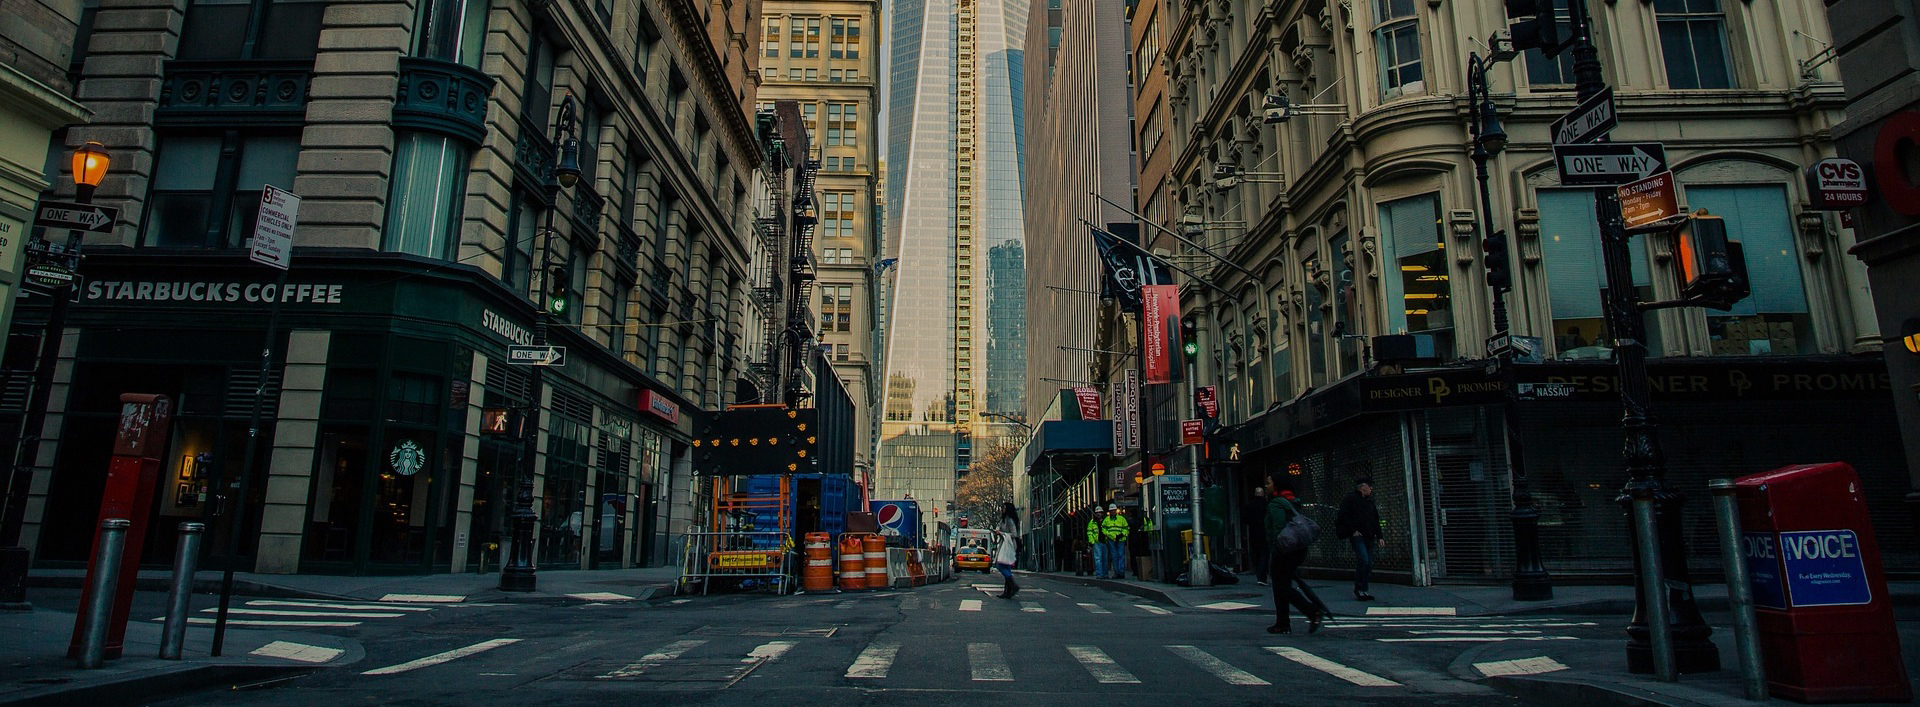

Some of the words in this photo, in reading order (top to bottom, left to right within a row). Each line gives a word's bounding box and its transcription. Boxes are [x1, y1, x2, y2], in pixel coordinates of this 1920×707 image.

[1562, 122, 1579, 144] ONE
[1586, 104, 1606, 129] WAY
[1574, 157, 1606, 172] ONE
[1618, 157, 1649, 172] WAY
[1820, 163, 1860, 179] CVS
[265, 188, 272, 202] 3
[1620, 188, 1630, 197] NO
[1632, 178, 1664, 194] STANDING
[1622, 196, 1642, 206] Monday
[1646, 190, 1662, 199] Friday
[263, 207, 289, 221] COMMERCIAL
[1639, 202, 1650, 211] 7pm
[47, 210, 69, 220] ONE
[80, 213, 103, 224] WAY
[261, 215, 281, 227] VEHICLES
[281, 222, 292, 230] ONLY
[88, 281, 241, 301] STARBUCKS
[244, 284, 342, 303] COFFEE
[483, 309, 530, 346] STARBUCKS
[1370, 387, 1422, 399] DESIGNER
[1457, 382, 1504, 393] PROMISE
[1548, 376, 1710, 392] DESINER
[1537, 388, 1569, 397] NASSAU
[1744, 535, 1775, 558] OICE
[1788, 534, 1856, 560] VOICE
